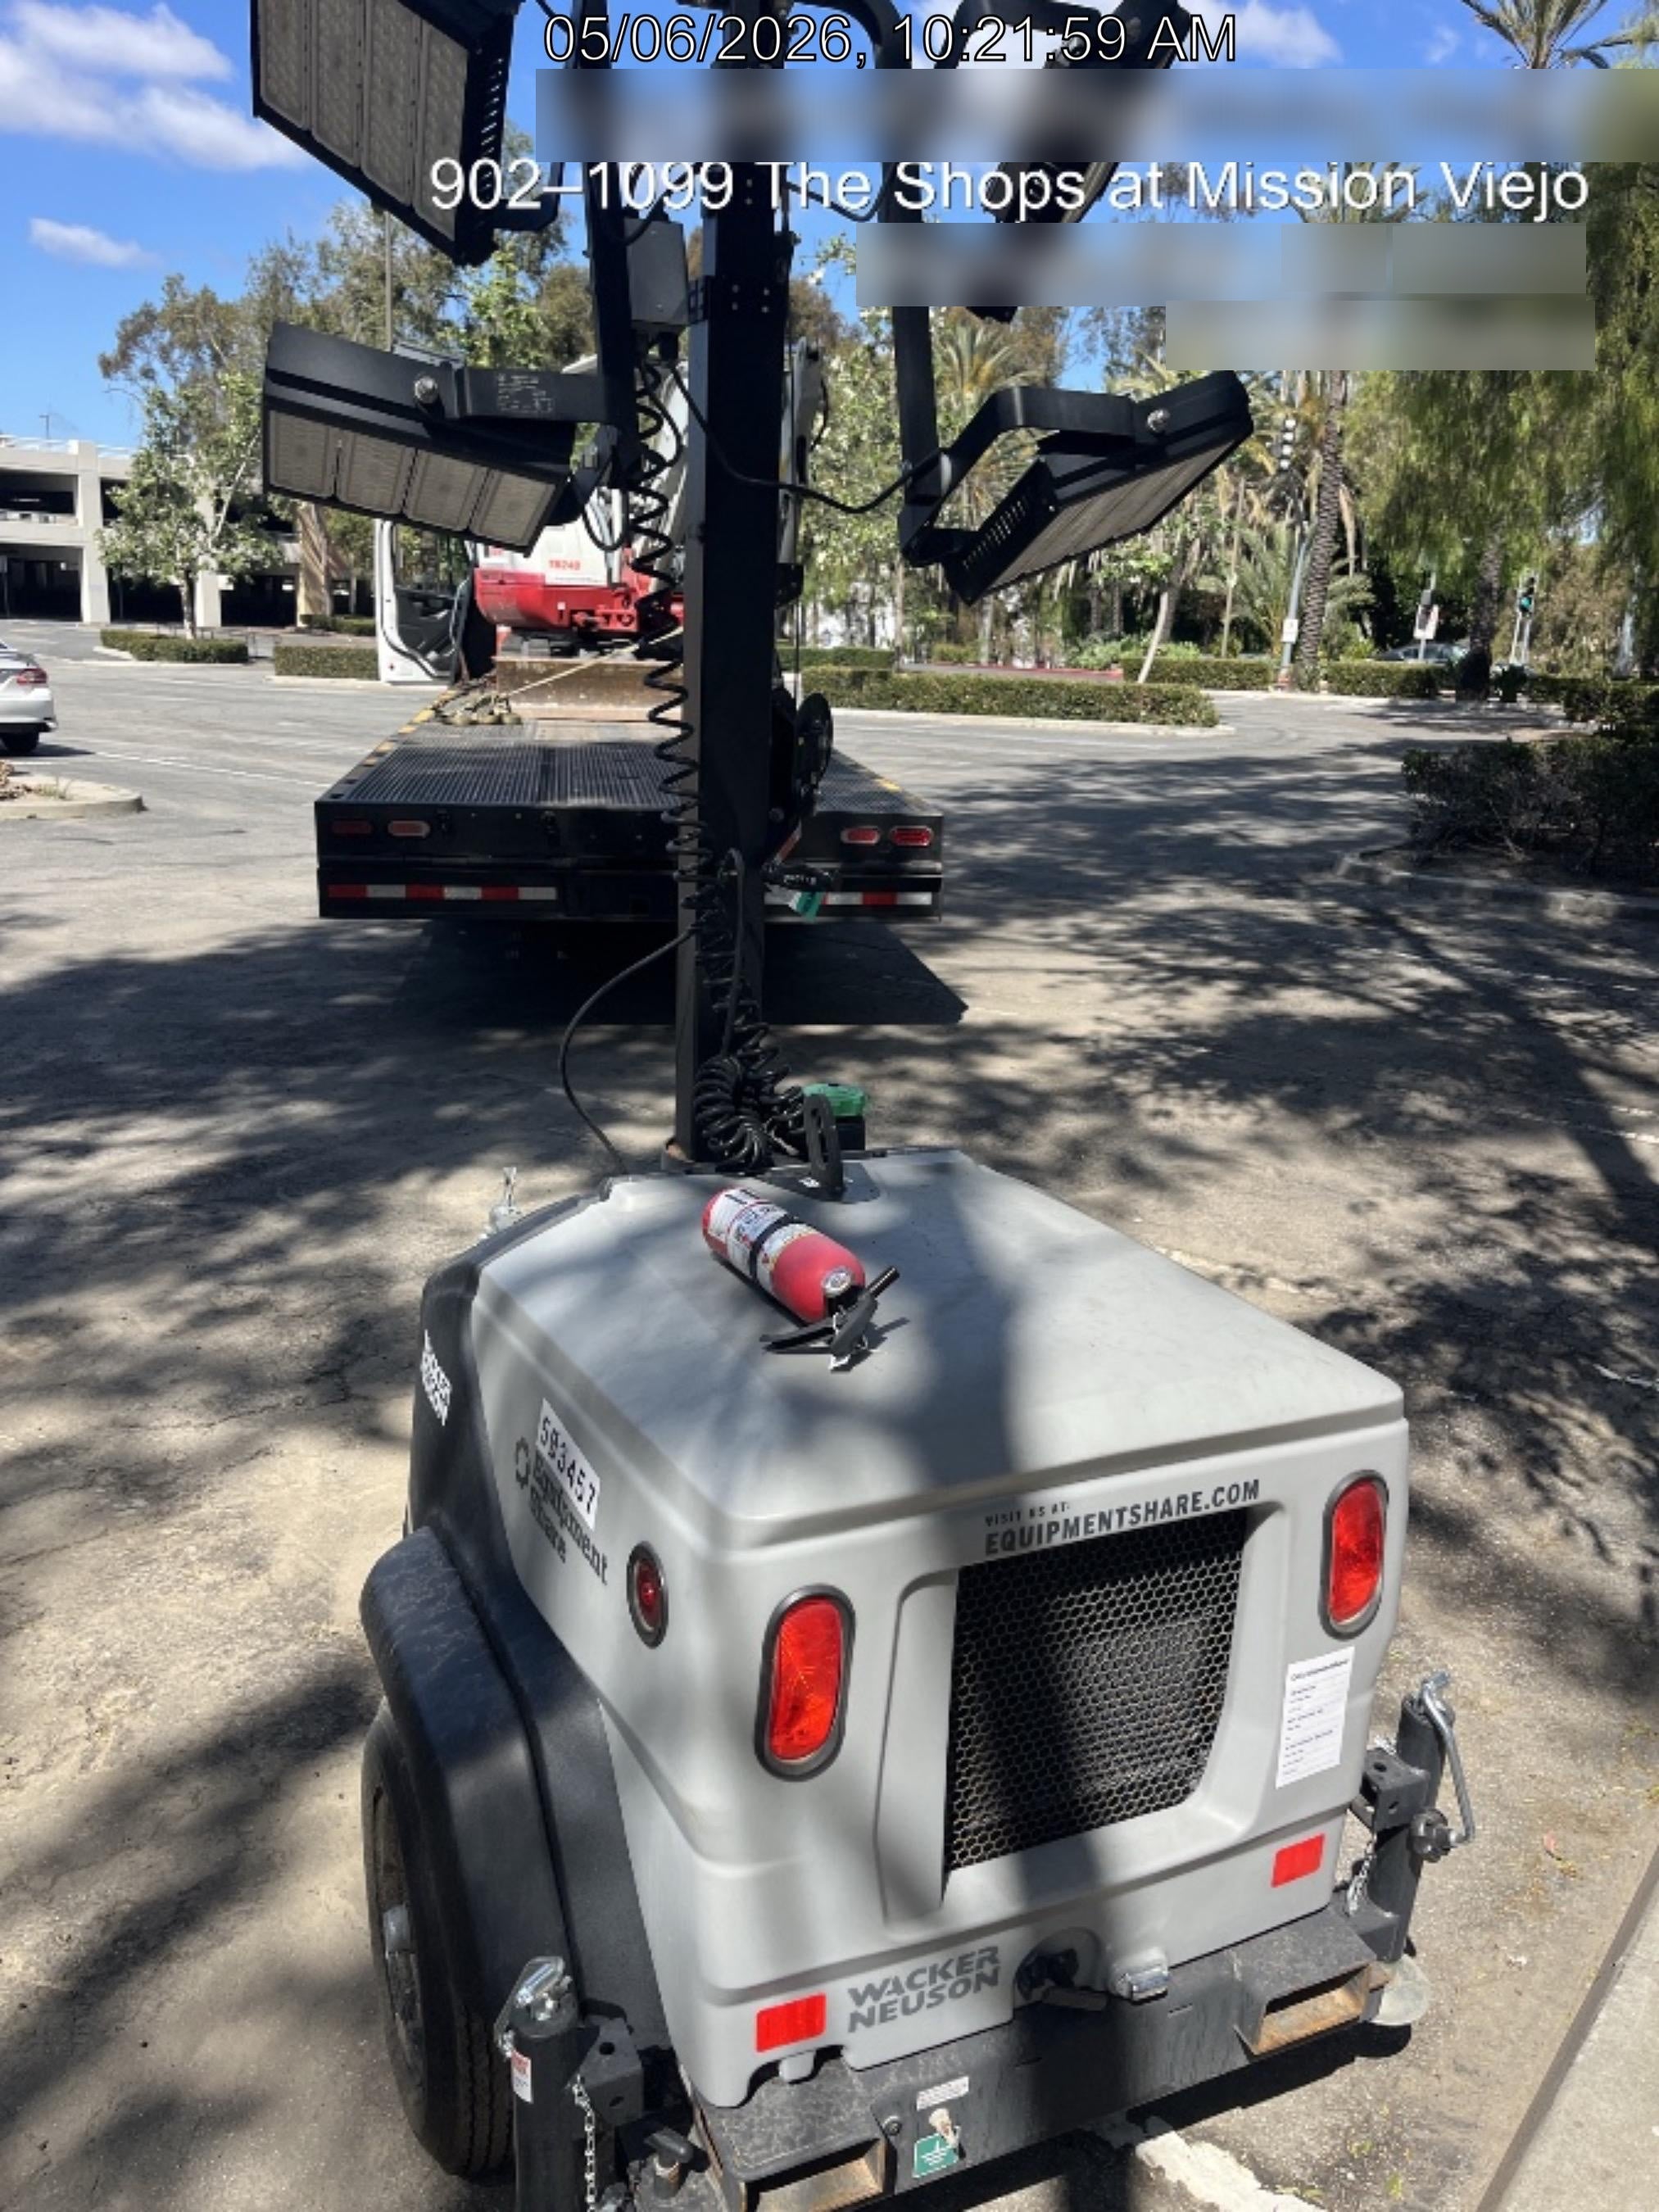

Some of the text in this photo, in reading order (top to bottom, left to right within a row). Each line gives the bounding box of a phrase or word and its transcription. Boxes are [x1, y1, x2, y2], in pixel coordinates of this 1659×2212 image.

[985, 1479, 1260, 1556] EQUIPMENTSHARE.COM
[847, 1946, 1001, 2007] WACKER
[847, 1966, 1000, 2033] NEUSON
